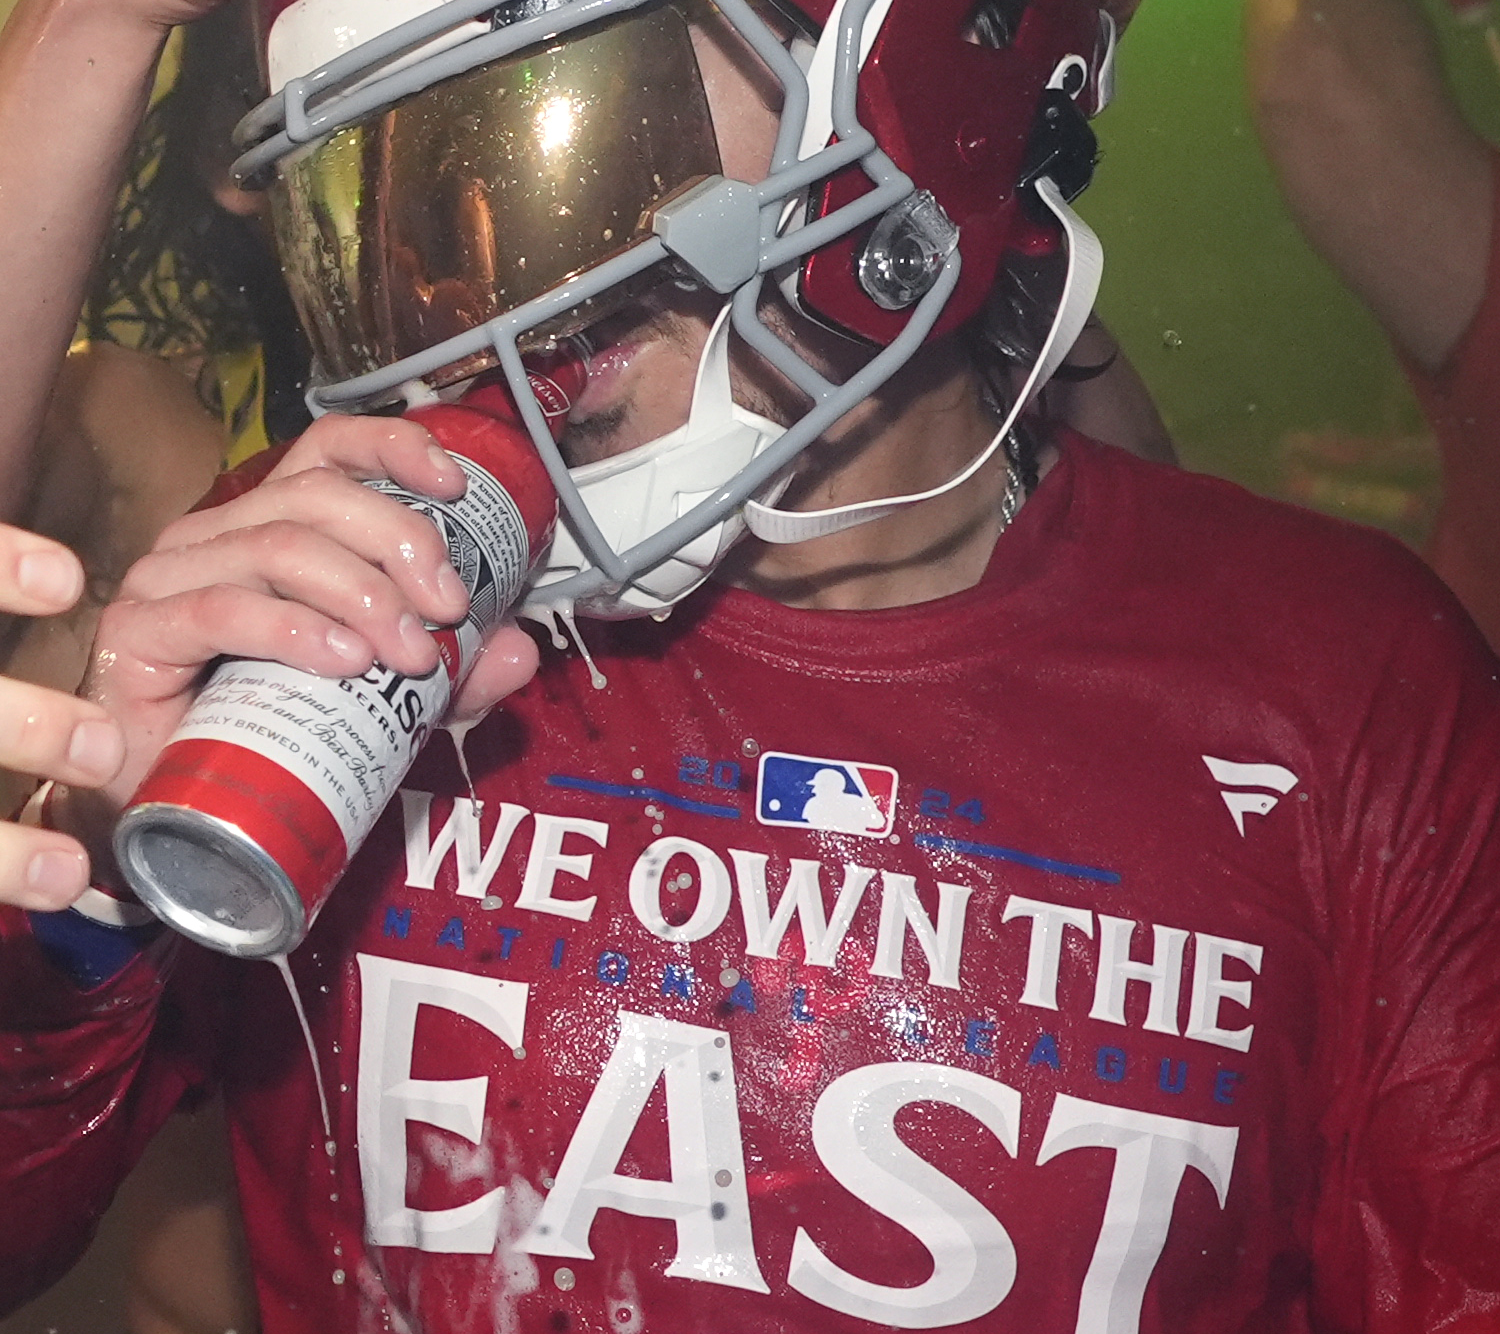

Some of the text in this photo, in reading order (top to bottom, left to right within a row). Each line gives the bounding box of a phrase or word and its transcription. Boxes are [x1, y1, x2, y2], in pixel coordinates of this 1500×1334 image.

[469, 489, 493, 513] much
[477, 483, 500, 506] know
[459, 507, 471, 519] no
[470, 518, 490, 541] other
[228, 687, 273, 711] Rice
[272, 705, 307, 729] and
[308, 722, 352, 761] Best
[268, 680, 338, 718] original
[330, 717, 377, 764] process
[234, 718, 301, 754] BREWED
[303, 752, 321, 769] IN
[322, 766, 346, 798] THE
[677, 755, 742, 790] 20
[919, 787, 987, 825] 24
[403, 788, 610, 923] WE
[627, 835, 975, 995] OWN
[1000, 894, 1265, 1054] THE
[381, 904, 1246, 1106] NATIONAL LEAGUE
